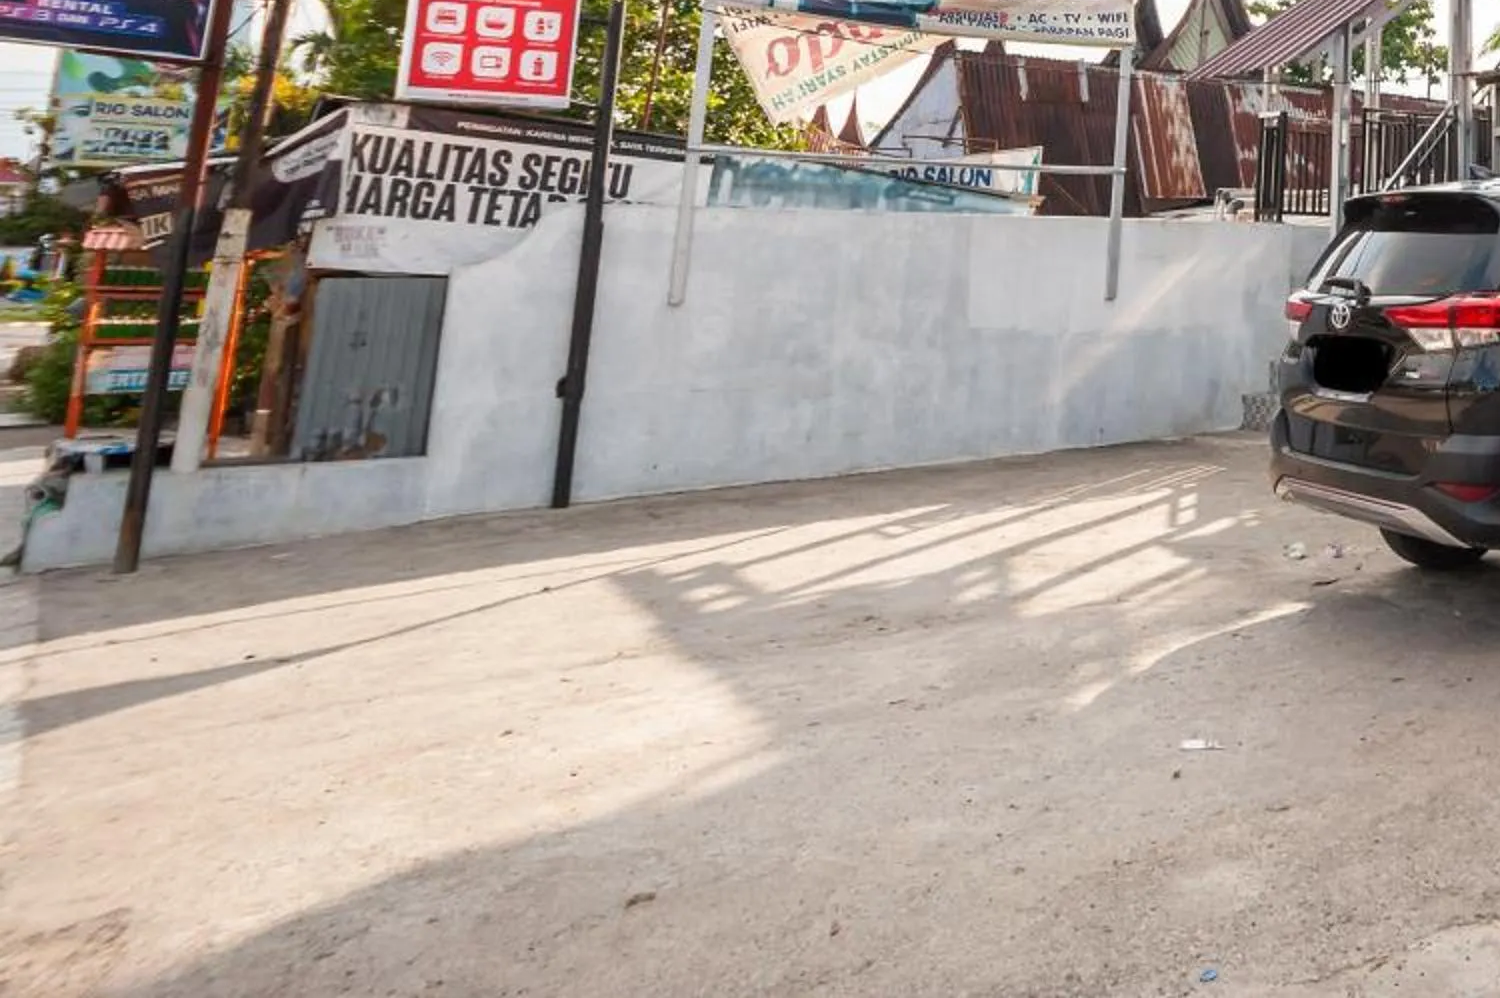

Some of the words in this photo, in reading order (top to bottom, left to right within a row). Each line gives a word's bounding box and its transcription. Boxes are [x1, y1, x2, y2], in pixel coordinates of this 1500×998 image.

[1064, 14, 1081, 24] TV
[131, 103, 189, 119] SALON
[349, 132, 509, 190] KUALITAS
[518, 154, 633, 199] SEGIU
[924, 165, 991, 187] SALON
